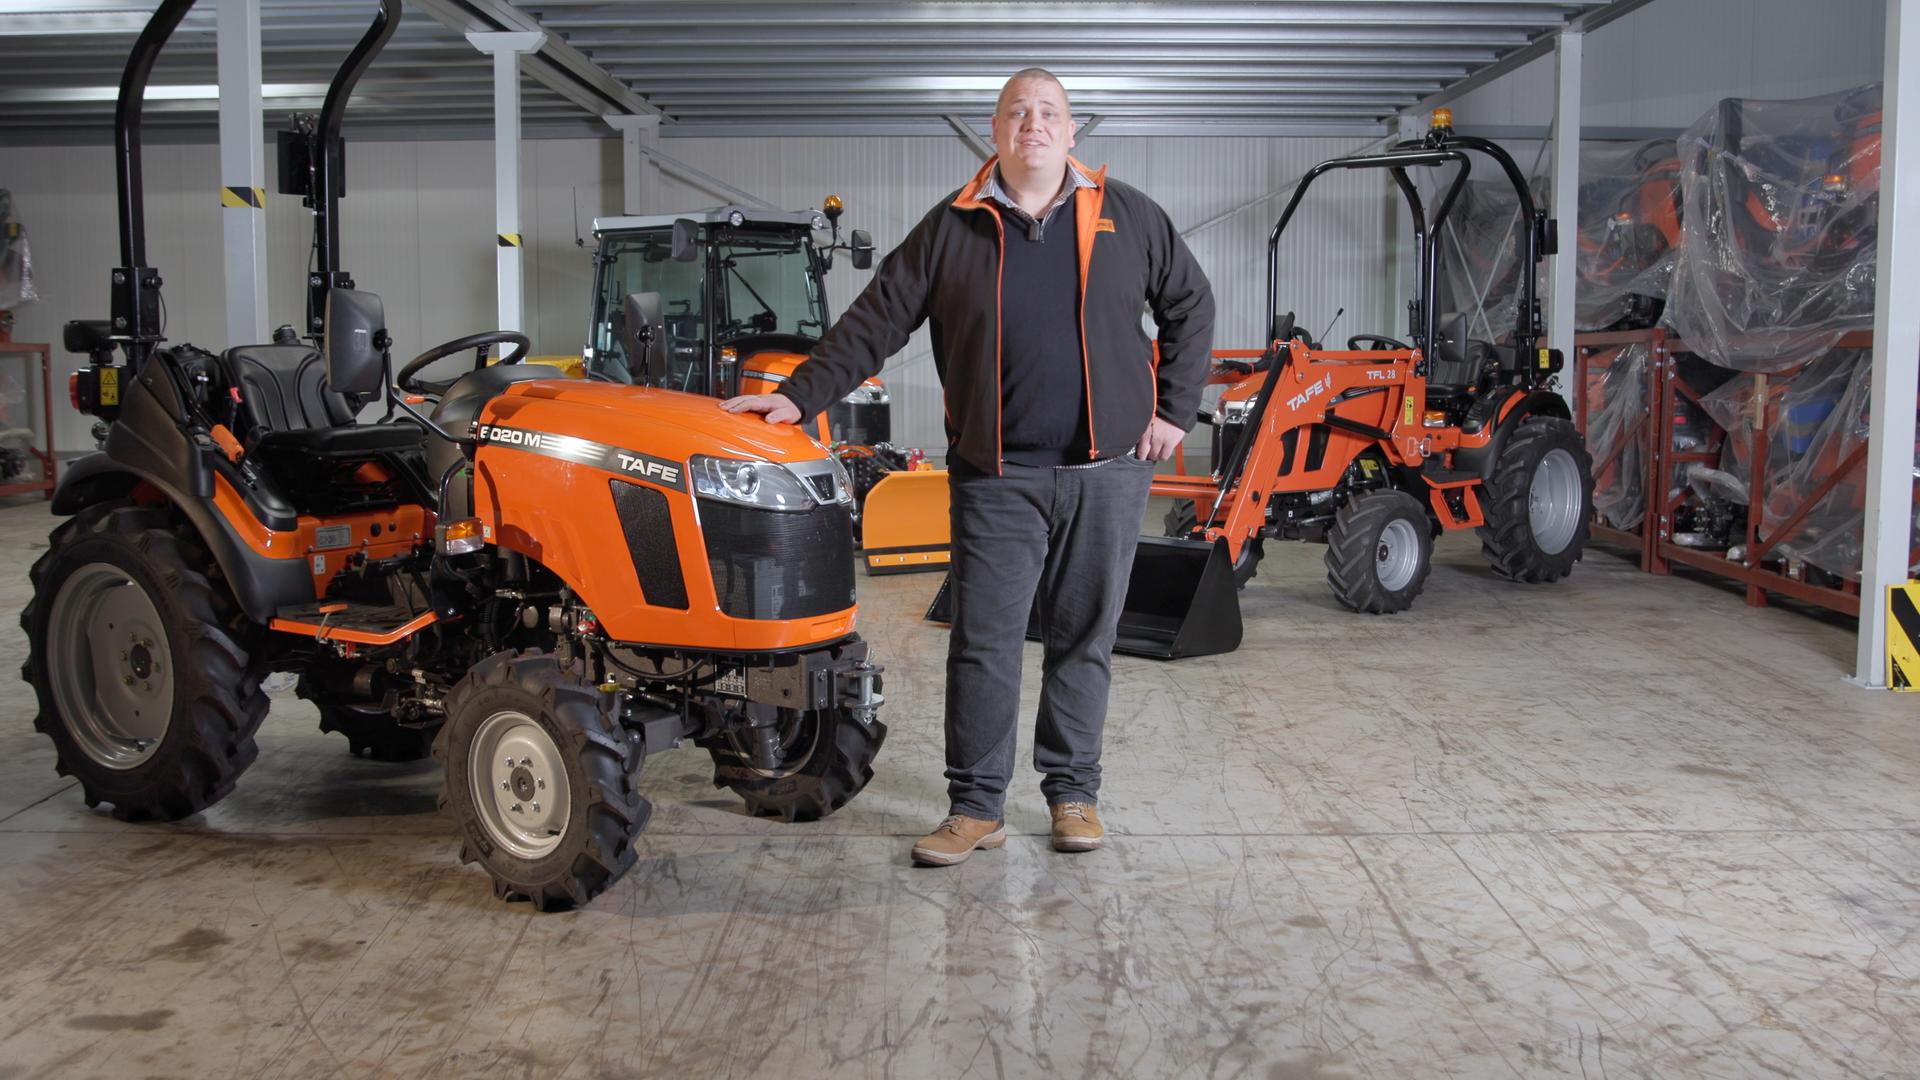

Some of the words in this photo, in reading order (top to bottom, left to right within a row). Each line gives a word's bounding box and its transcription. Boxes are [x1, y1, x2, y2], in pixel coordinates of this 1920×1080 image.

[1366, 370, 1386, 380] TFL
[1286, 379, 1324, 411] TAFE
[524, 432, 541, 448] M
[617, 453, 679, 483] TAFE
